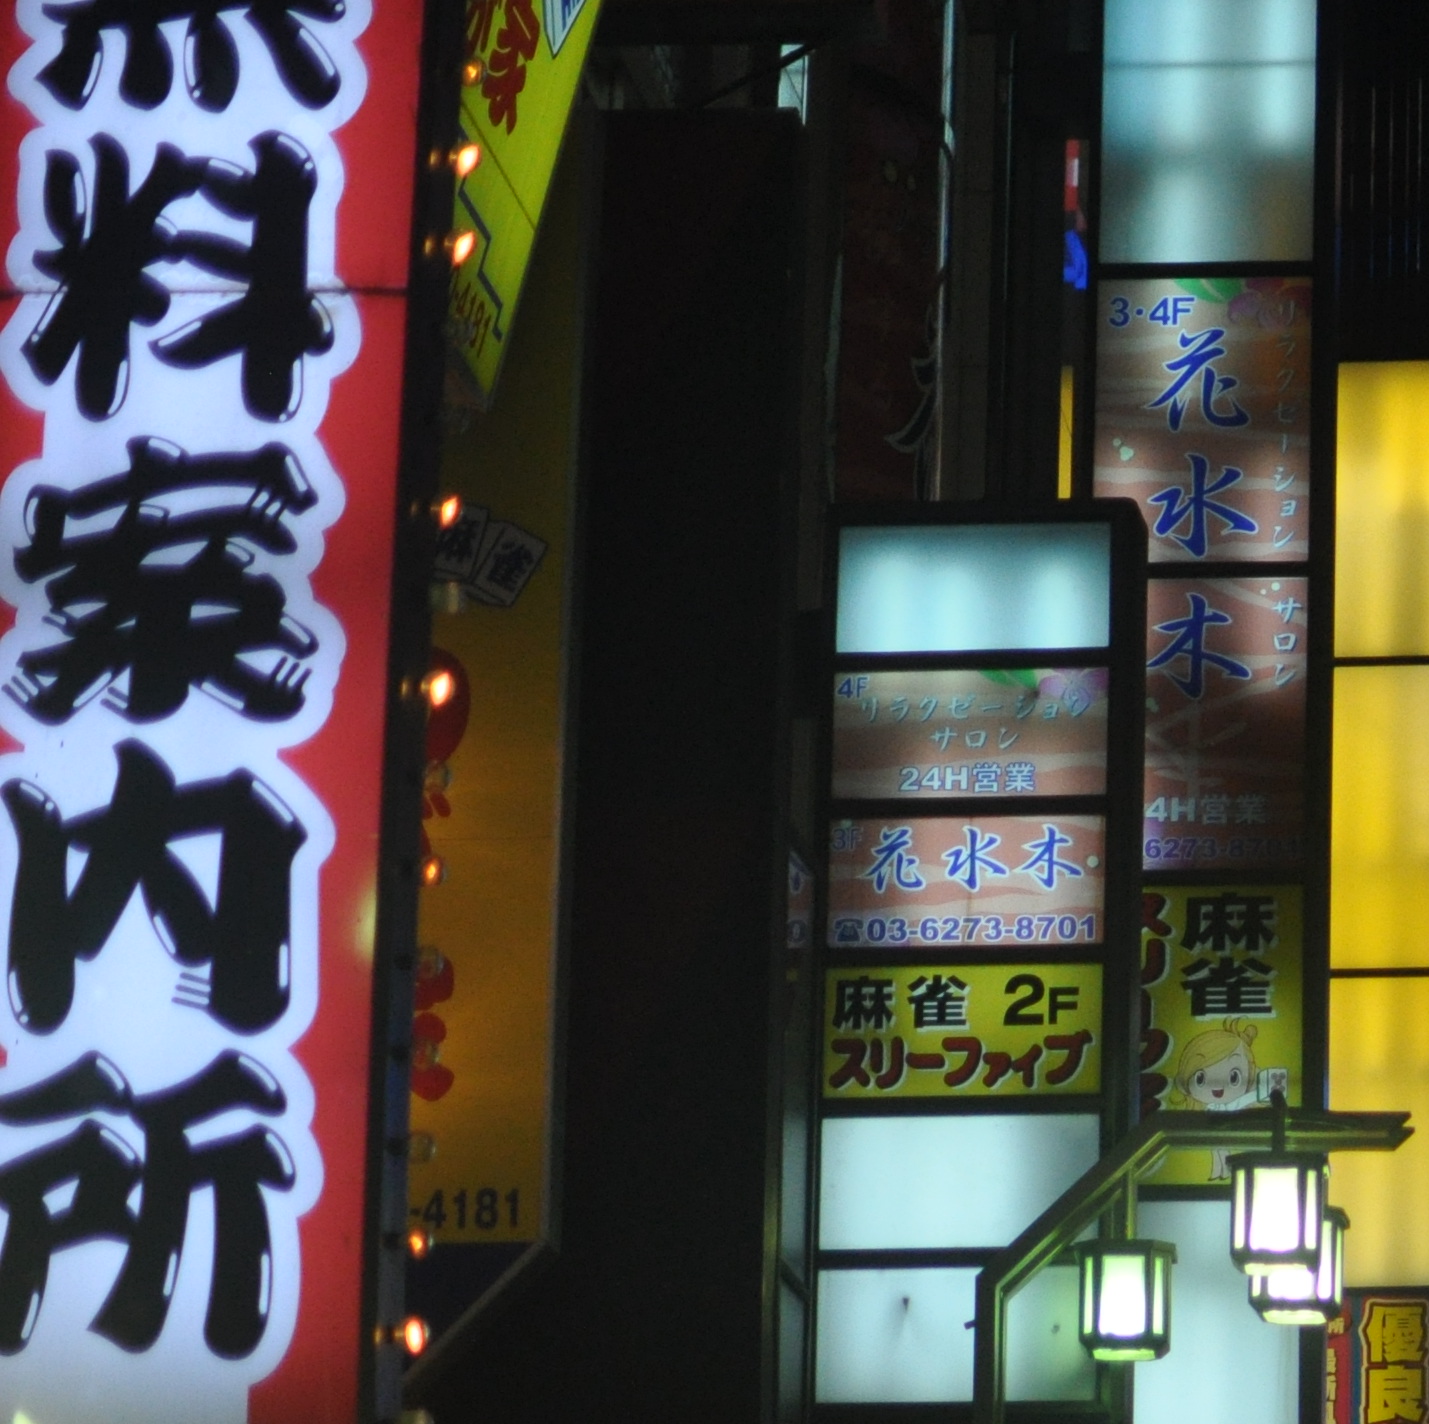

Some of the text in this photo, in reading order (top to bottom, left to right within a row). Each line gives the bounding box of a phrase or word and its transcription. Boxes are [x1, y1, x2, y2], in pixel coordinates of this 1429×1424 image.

[1147, 328, 1258, 699] 花水木
[1271, 595, 1304, 689] サロン
[838, 677, 868, 699] 4F
[931, 725, 1021, 752] サロン
[900, 762, 1036, 794] 24H営業
[866, 825, 1083, 893] 花水木
[867, 915, 1098, 943] 03-6273-8701
[1183, 892, 1277, 1020] 麻雀
[833, 973, 1080, 1031] 麻雀 2F
[829, 1030, 1094, 1092] スリーファイブ
